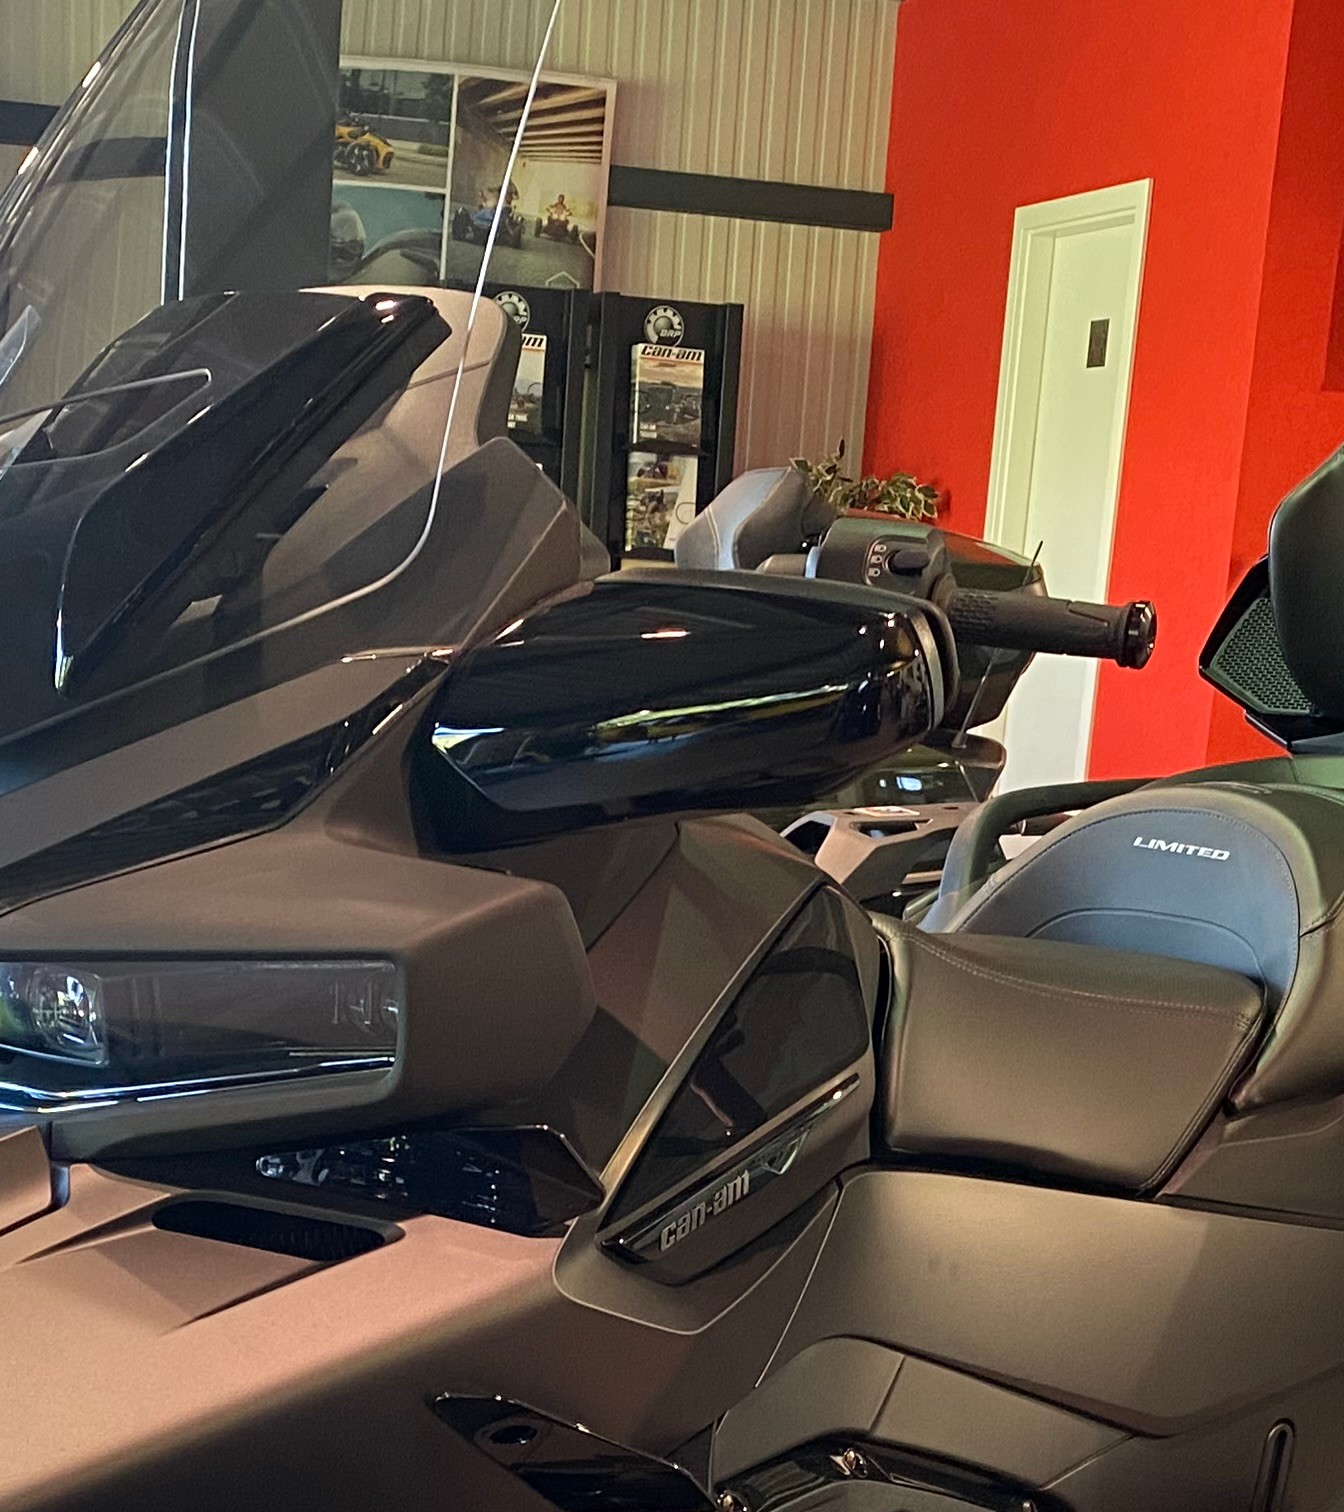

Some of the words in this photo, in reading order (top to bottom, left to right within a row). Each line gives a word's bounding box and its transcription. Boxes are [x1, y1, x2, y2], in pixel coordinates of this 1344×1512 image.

[659, 328, 682, 338] BRP
[641, 345, 702, 361] can-am
[1132, 836, 1231, 861] LIMITED
[660, 1169, 751, 1252] can-am
